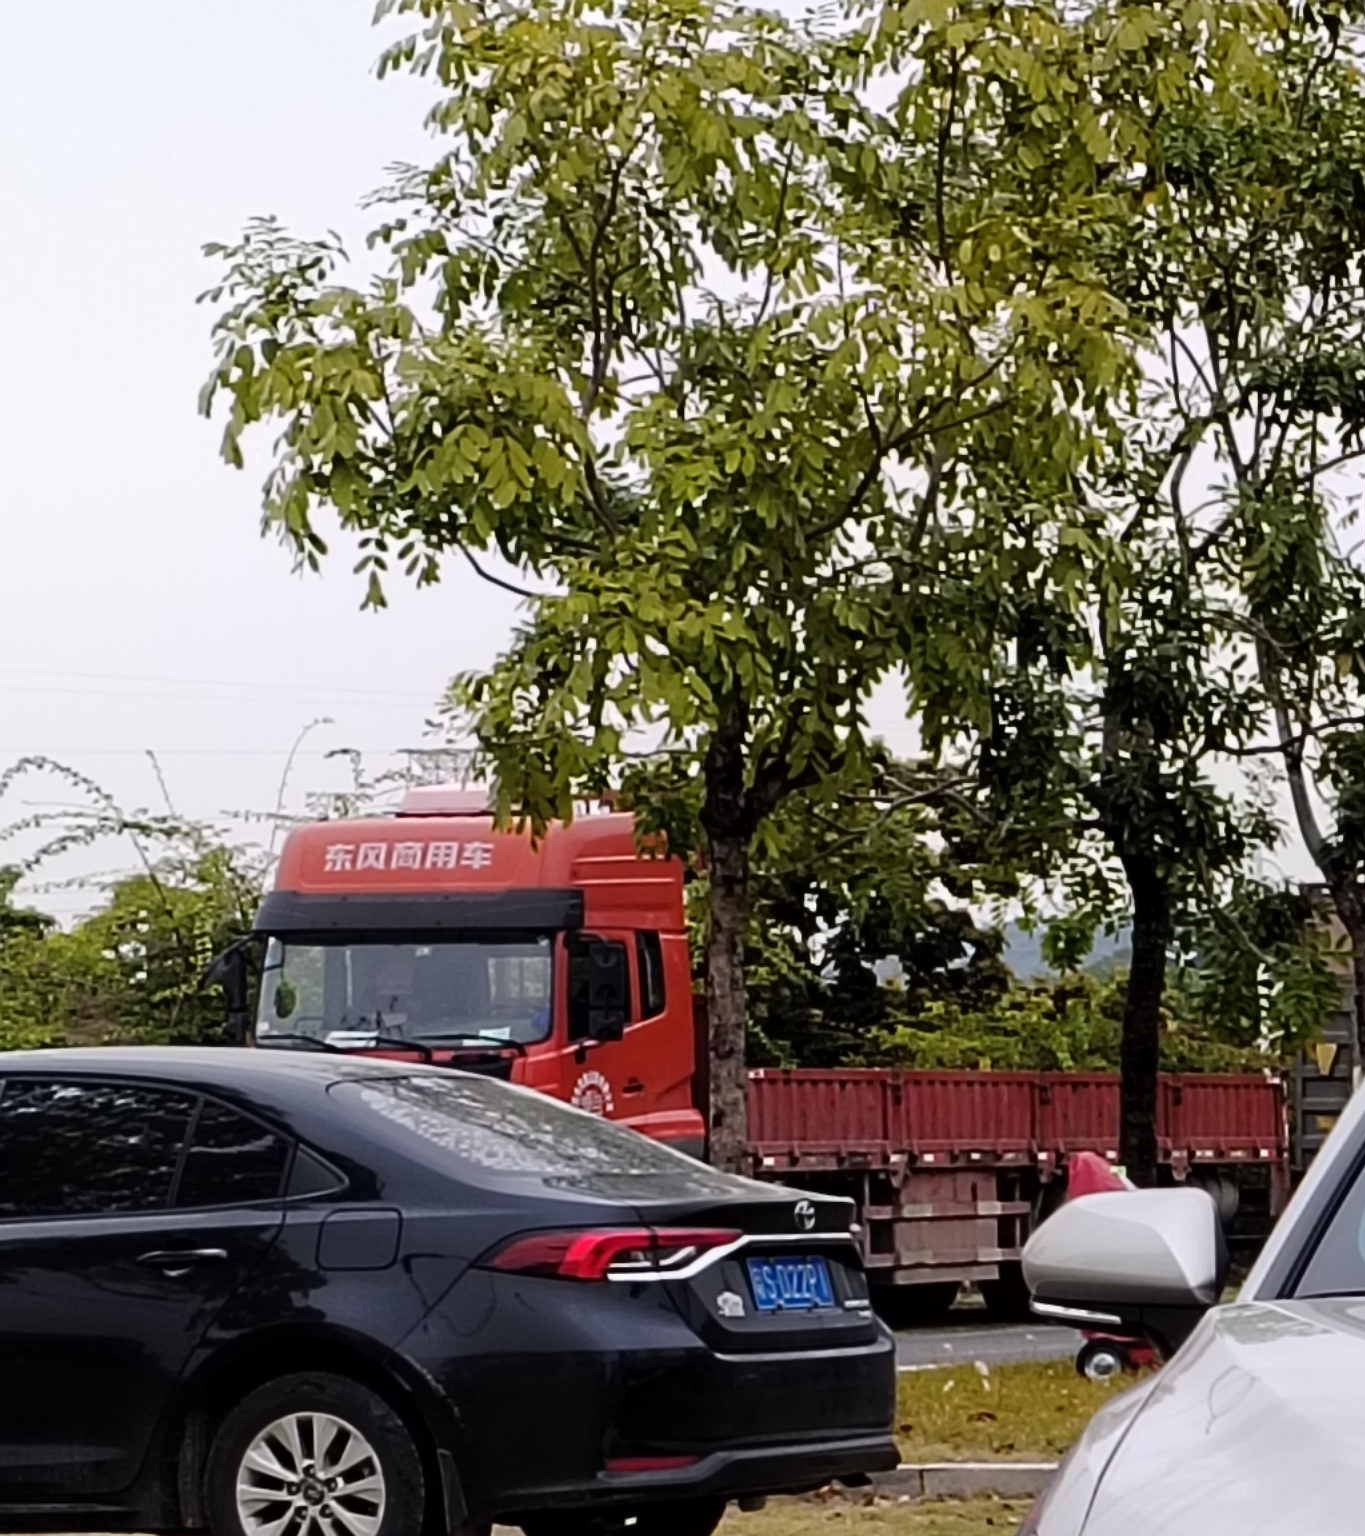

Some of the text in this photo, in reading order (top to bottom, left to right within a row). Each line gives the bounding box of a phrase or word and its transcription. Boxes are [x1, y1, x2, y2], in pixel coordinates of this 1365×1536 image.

[324, 841, 495, 872] 东风商用车
